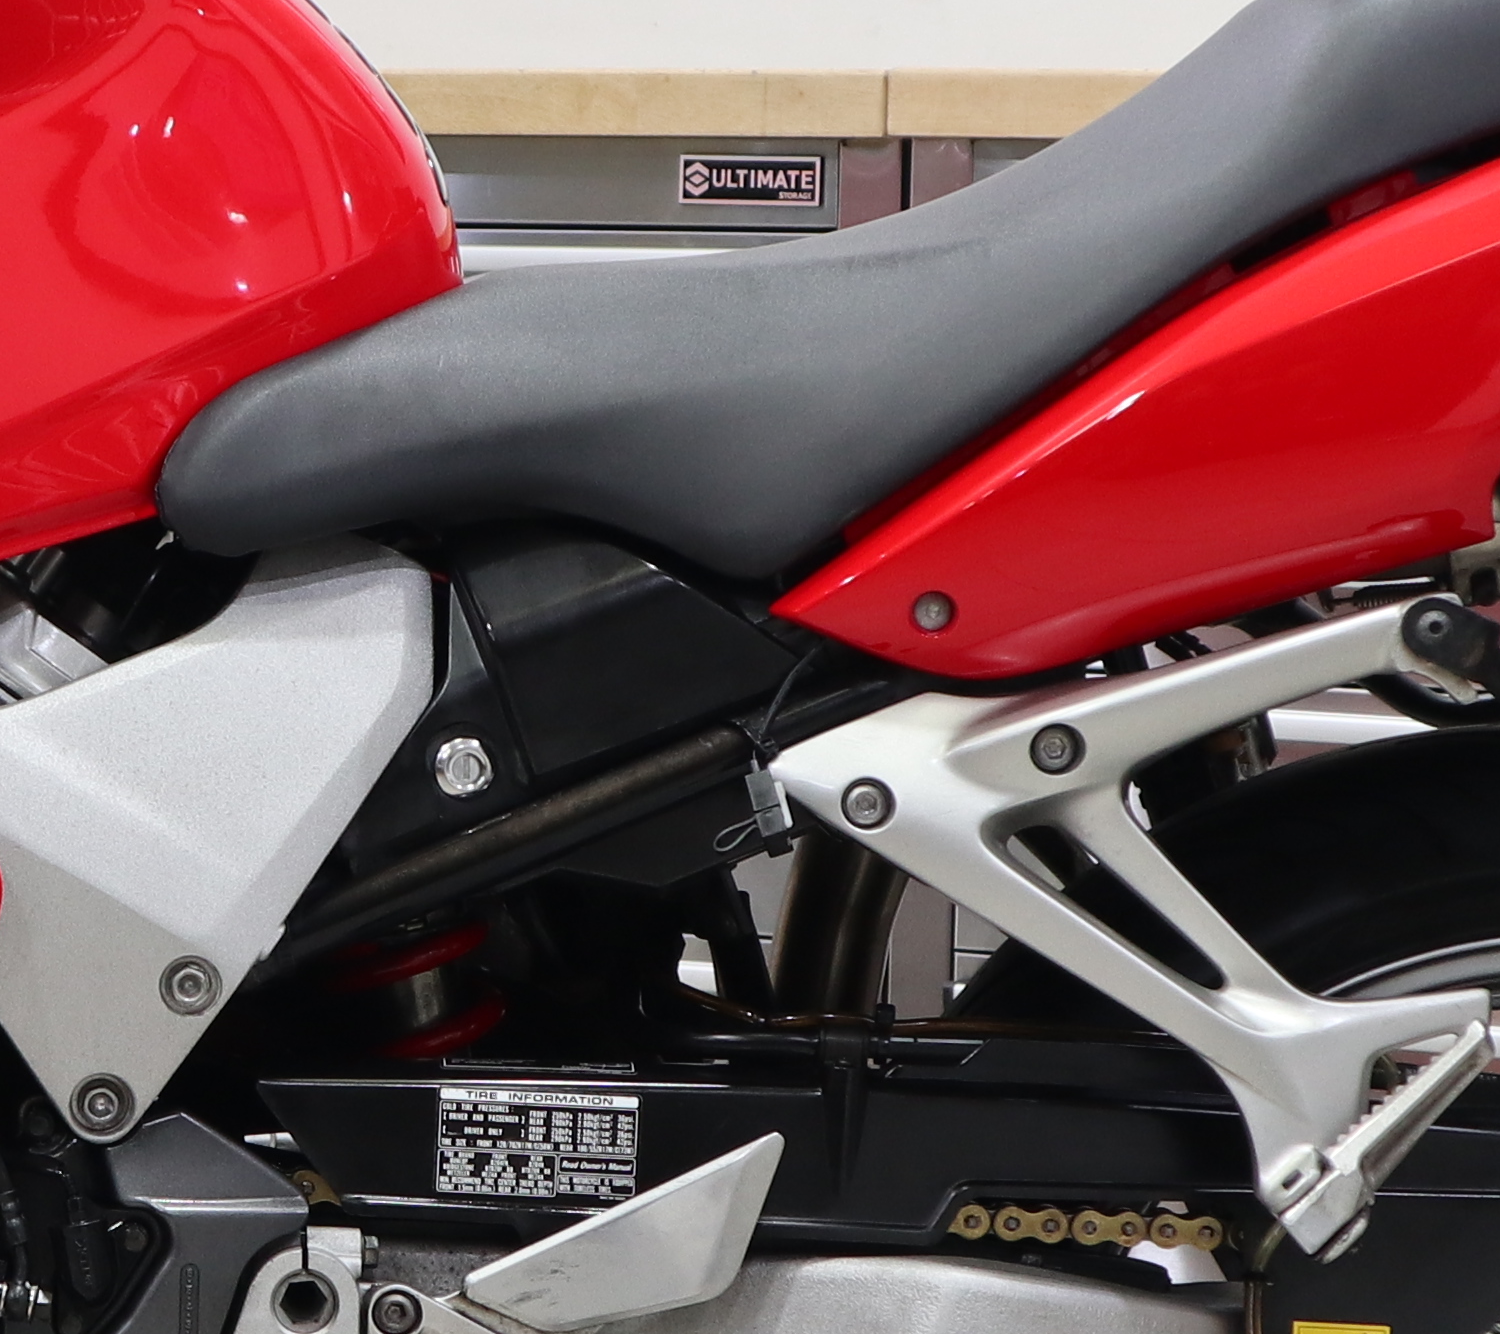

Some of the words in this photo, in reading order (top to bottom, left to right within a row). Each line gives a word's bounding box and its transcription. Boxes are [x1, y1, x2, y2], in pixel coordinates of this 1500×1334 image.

[712, 169, 814, 190] ULTIMATE
[778, 191, 812, 200] STORAGE
[465, 1090, 498, 1100] TIRE
[508, 1092, 614, 1106] INFORMATION
